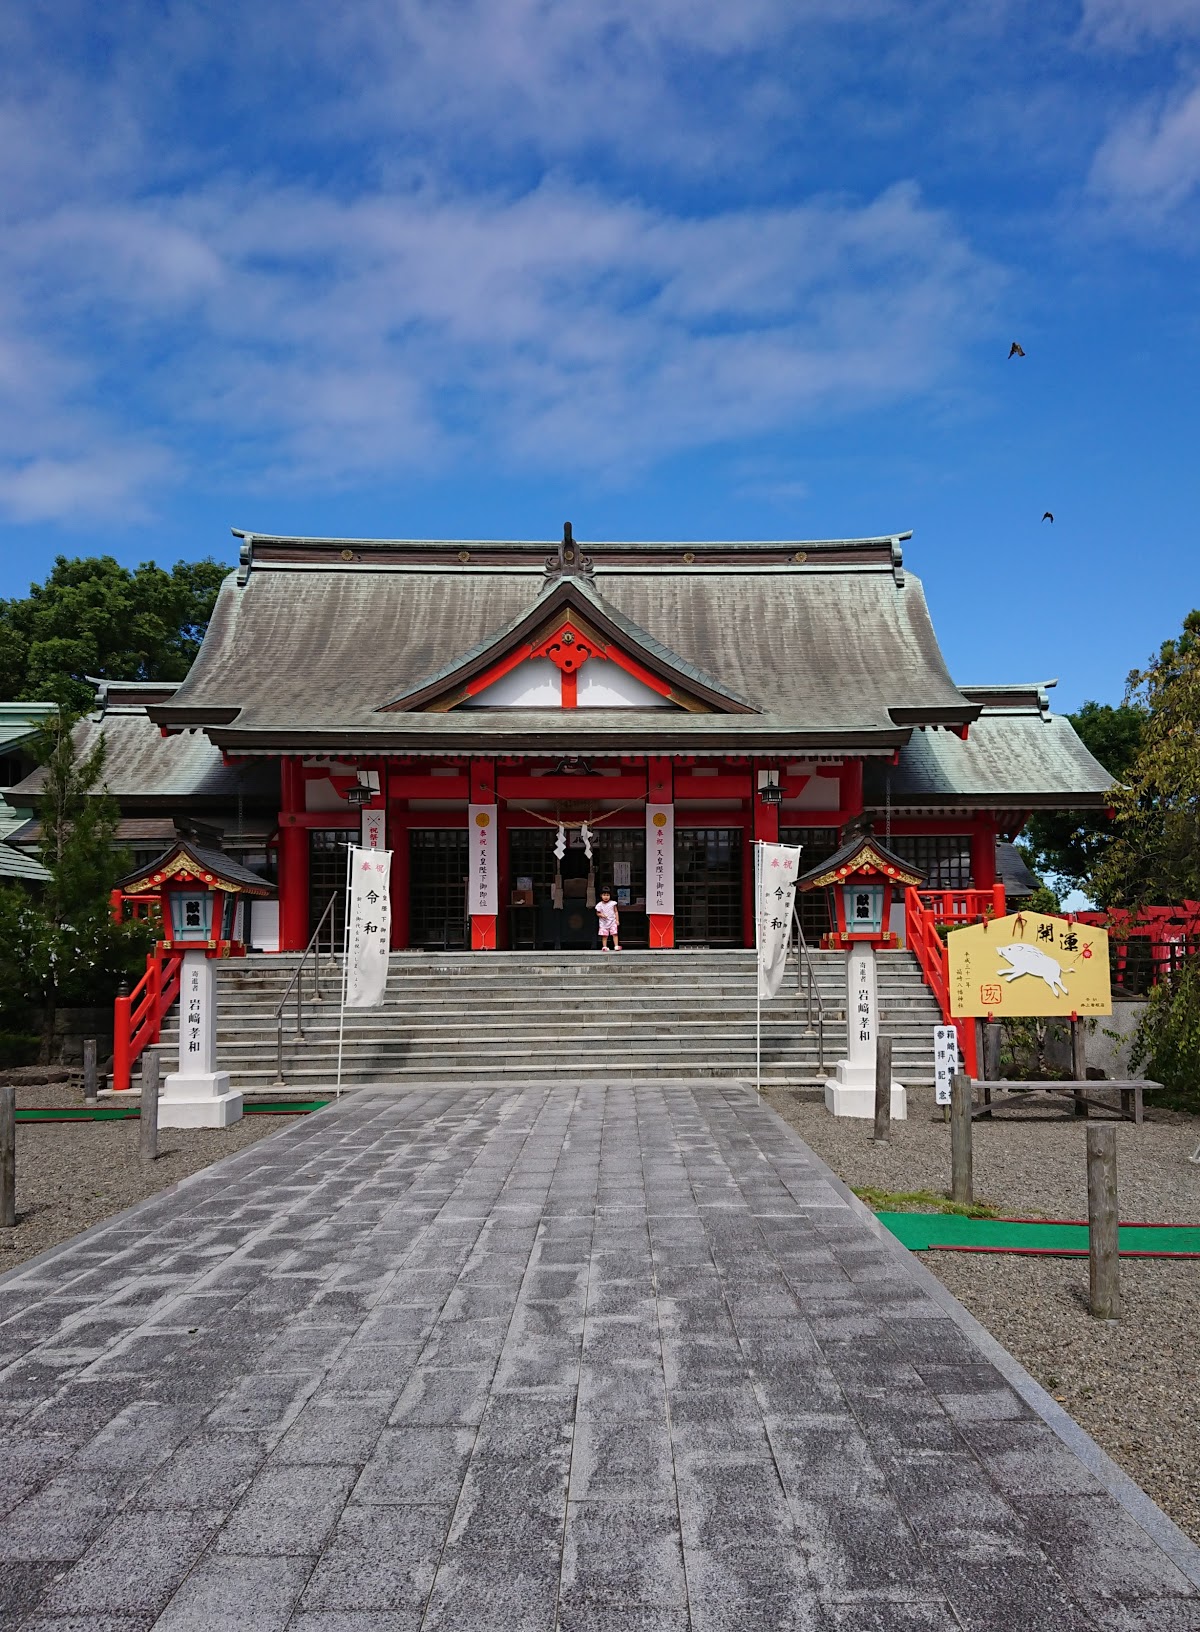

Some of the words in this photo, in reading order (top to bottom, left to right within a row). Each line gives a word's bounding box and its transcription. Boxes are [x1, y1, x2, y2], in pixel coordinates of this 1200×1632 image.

[369, 827, 379, 847] 祝祭日
[479, 829, 487, 846] 奉祝
[656, 829, 664, 845] 奉祝
[361, 861, 385, 873] 奉祝
[770, 858, 793, 870] 奉祝
[478, 849, 488, 907] 天皇陛下御即位
[655, 849, 665, 906] 天皇陛下御即位
[363, 889, 380, 935] 令和
[770, 886, 784, 930] 令和
[1035, 922, 1079, 952] 開運
[191, 970, 199, 992] 寄進者
[859, 962, 867, 983] 寄進者
[936, 1030, 947, 1100] 参拝記念
